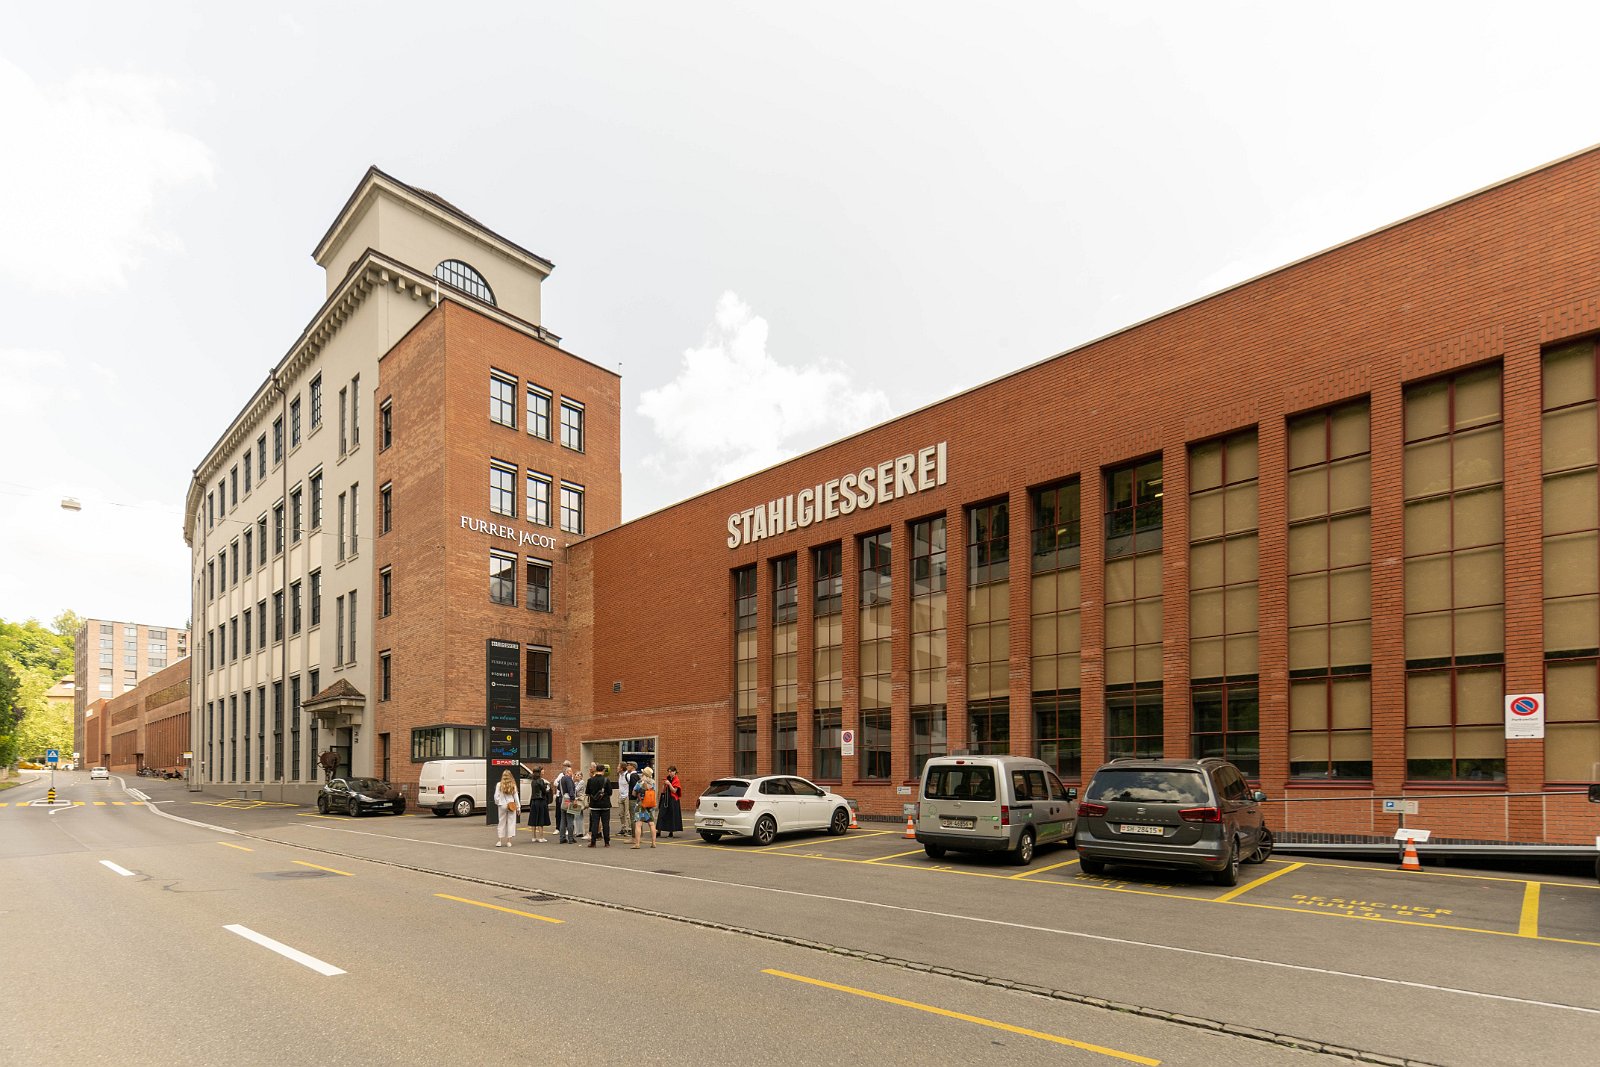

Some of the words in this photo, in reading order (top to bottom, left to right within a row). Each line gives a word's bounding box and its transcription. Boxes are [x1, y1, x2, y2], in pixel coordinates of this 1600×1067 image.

[727, 441, 948, 549] STAHLGIESSEREI
[460, 515, 517, 541] FURRER
[518, 530, 557, 550] JACOT
[1291, 894, 1453, 915] BESUCHER
[1297, 900, 1375, 912] HUUS
